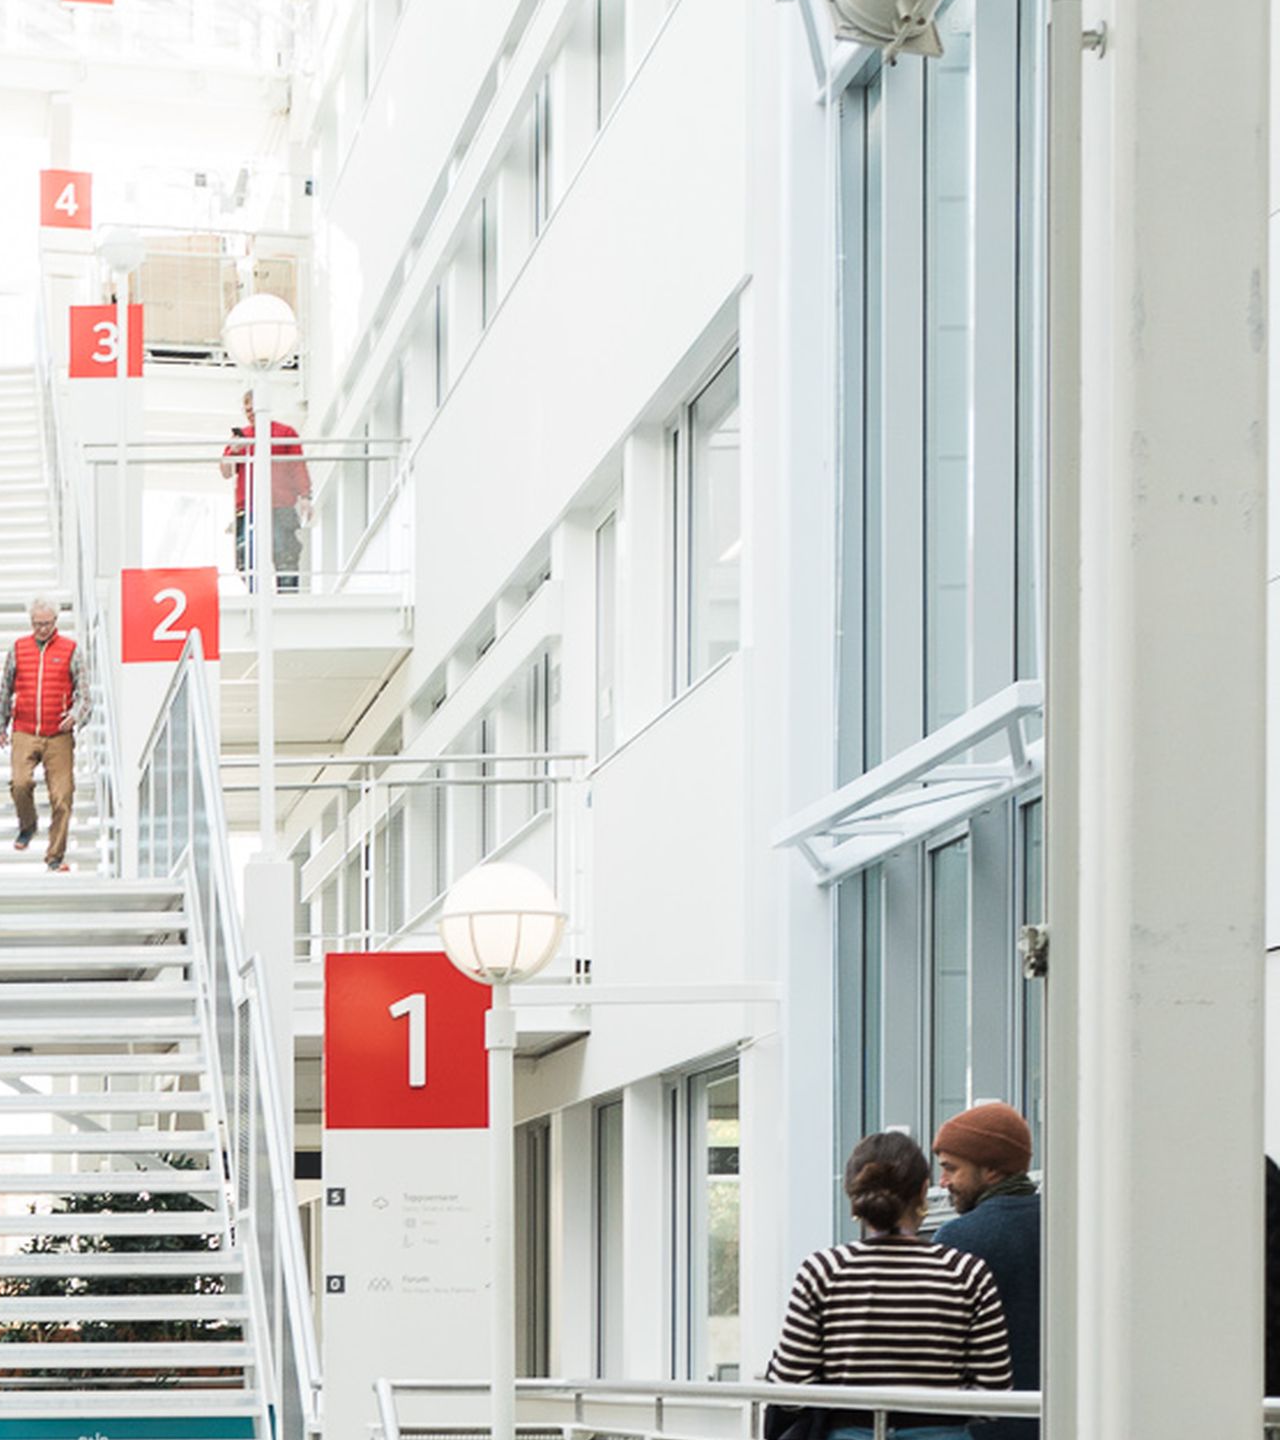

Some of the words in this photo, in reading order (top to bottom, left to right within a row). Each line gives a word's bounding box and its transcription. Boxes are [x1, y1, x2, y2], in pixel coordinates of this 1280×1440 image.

[54, 183, 79, 216] 4
[91, 321, 118, 363] 3
[151, 587, 188, 641] 2
[388, 992, 427, 1088] 1
